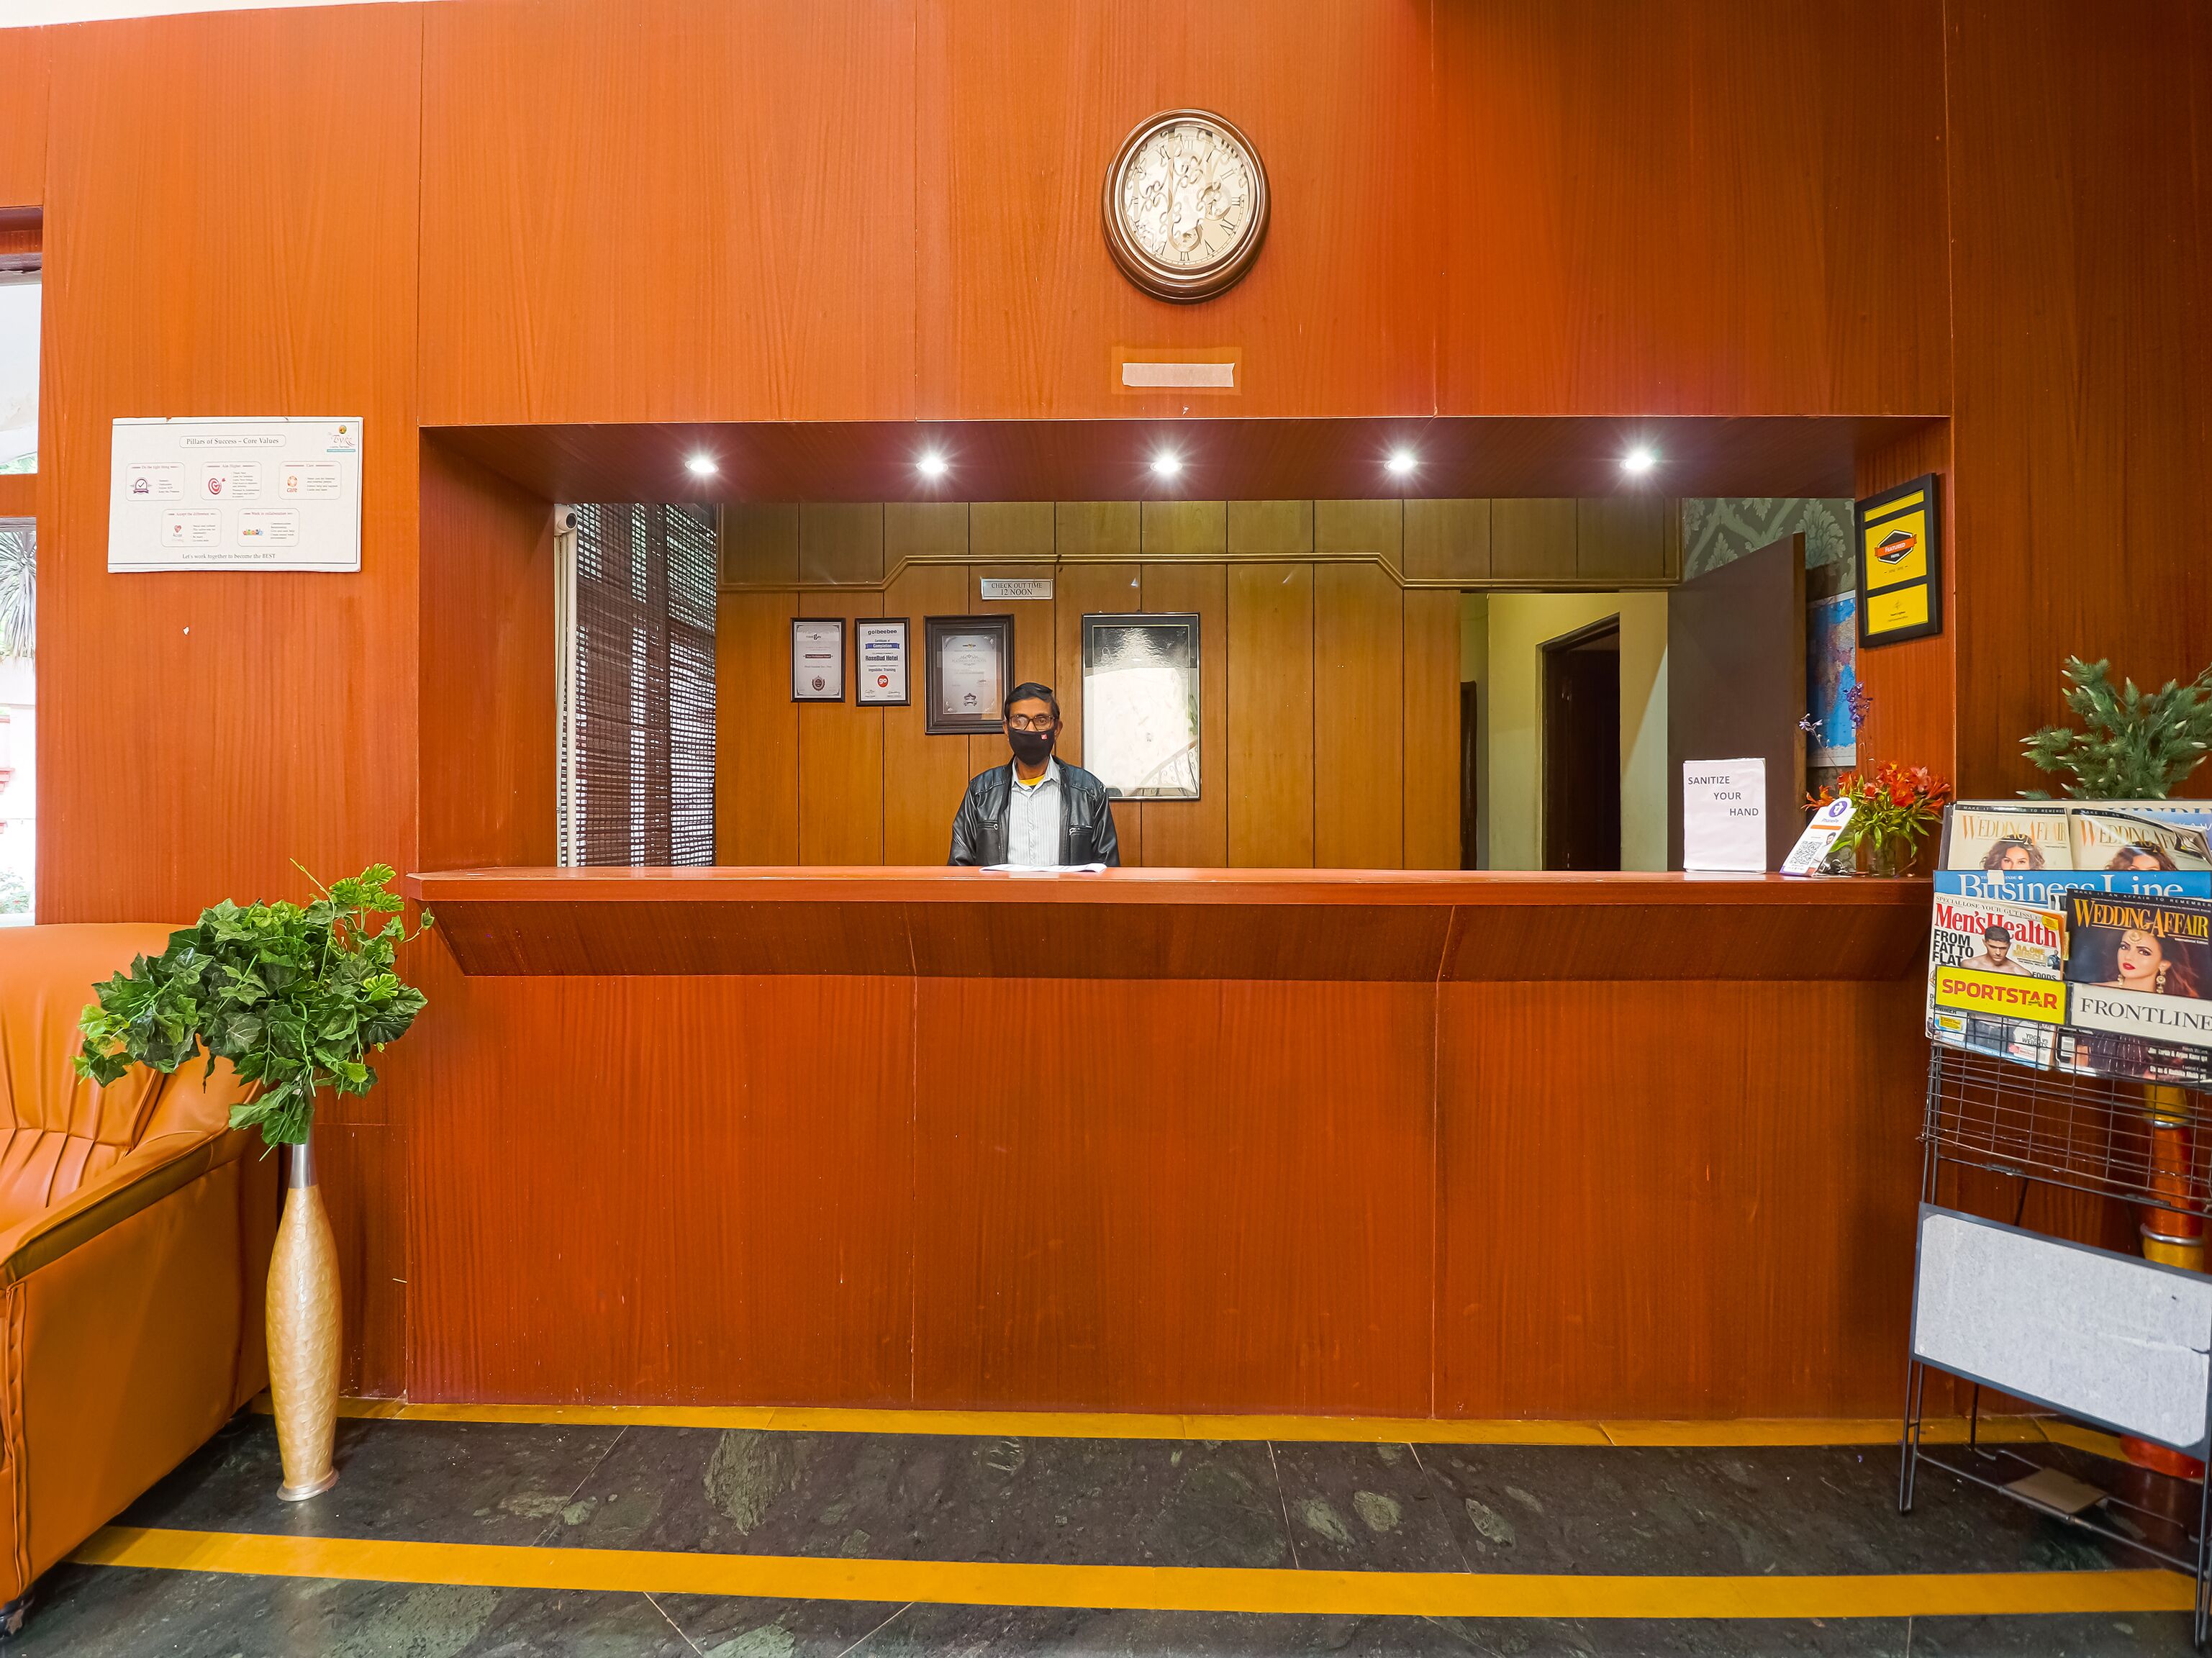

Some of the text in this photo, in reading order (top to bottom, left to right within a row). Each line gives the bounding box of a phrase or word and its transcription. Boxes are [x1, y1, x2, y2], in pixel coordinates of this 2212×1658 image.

[1885, 542, 1905, 553] FEATURED
[1688, 776, 1730, 785] SANITIZE
[1713, 792, 1741, 800] YOUR
[1729, 807, 1759, 816] HAND
[1936, 896, 1962, 906] SPECIAL
[2170, 899, 2211, 907] REMEMBER
[2073, 898, 2154, 930] WEDDING
[2151, 907, 2208, 938] AFFAIR
[1934, 928, 1970, 946] FROM
[1933, 941, 1974, 958] FAT TO
[1932, 951, 1962, 967] FLAT
[1941, 979, 2057, 1010] SPORTSTAR
[2080, 997, 2212, 1031] FRONTLINE
